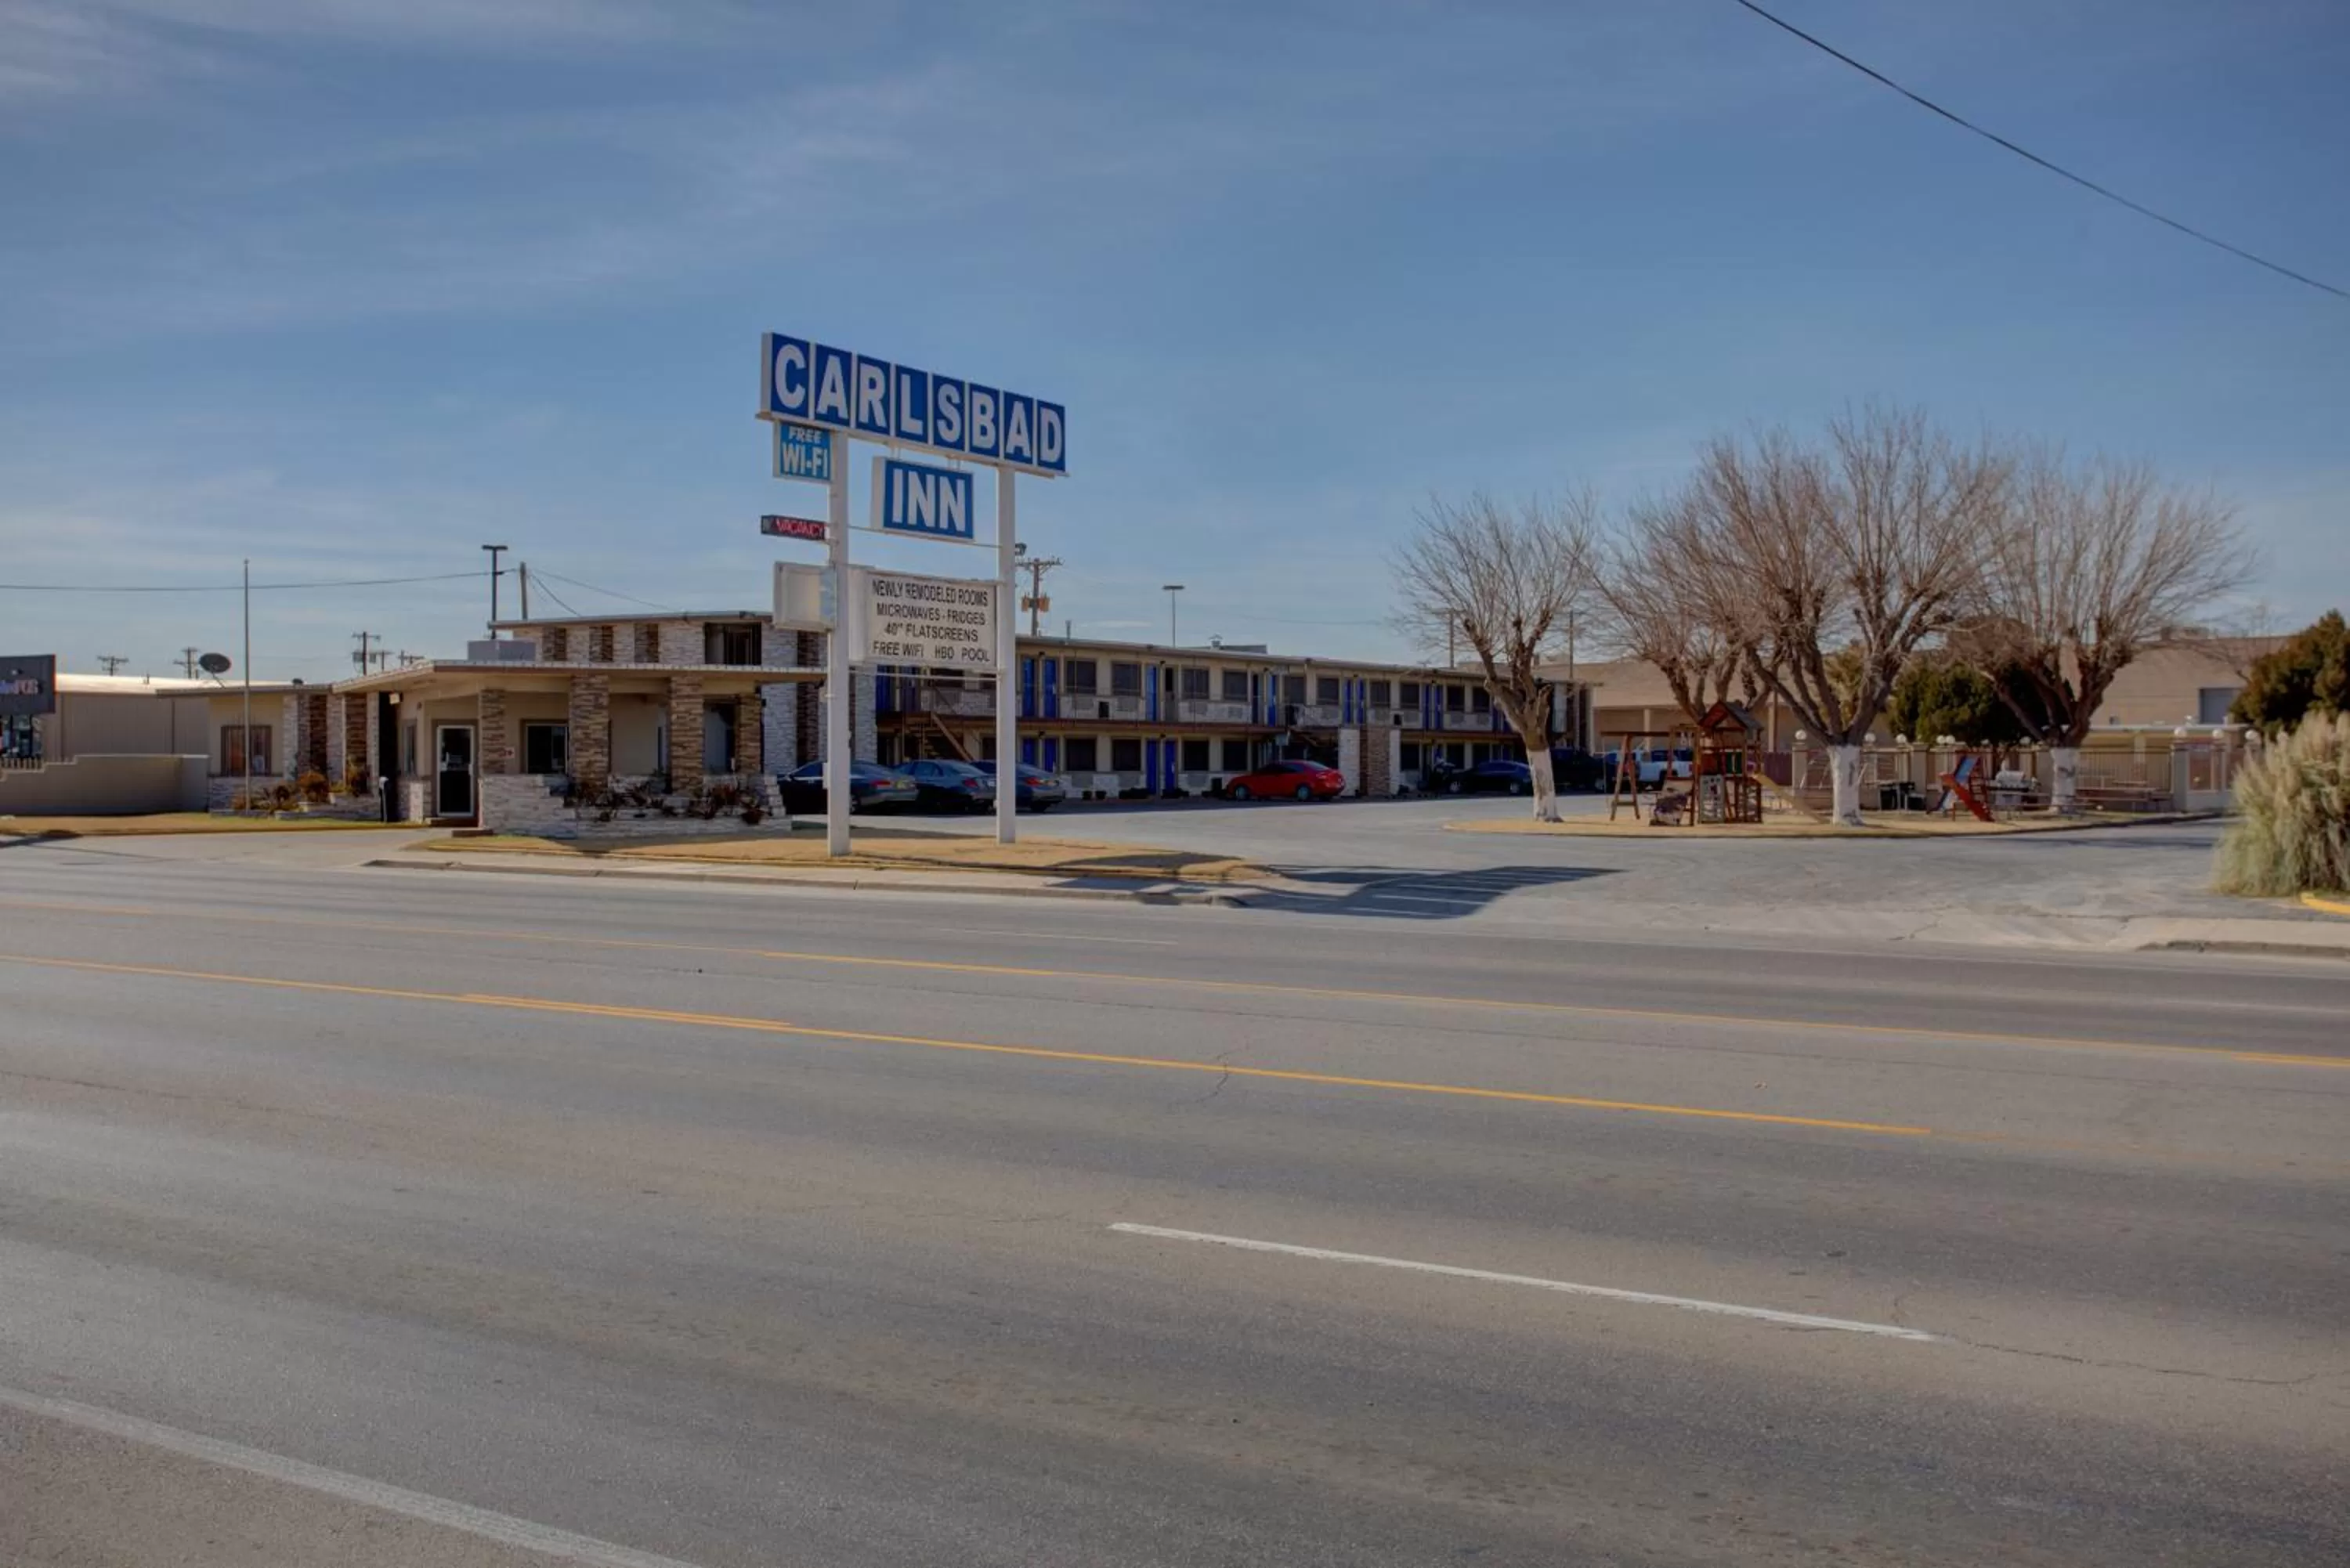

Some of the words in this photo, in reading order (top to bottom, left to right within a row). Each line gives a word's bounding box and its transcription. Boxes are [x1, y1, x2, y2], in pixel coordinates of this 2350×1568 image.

[774, 344, 1062, 463] CARLSBAD
[788, 425, 821, 443] FREE
[783, 441, 828, 477] WI-FI
[891, 468, 966, 532] INN
[776, 517, 824, 537] VACANCY
[872, 579, 903, 598] NEWLY
[905, 583, 956, 603] REMODELED
[958, 588, 988, 607] ROOMS
[877, 602, 940, 621] MICROWAVES
[946, 609, 985, 626] FRIDGES
[906, 623, 978, 642] FLATSCREENS
[873, 641, 900, 656] FREE
[902, 643, 924, 658] WIFI
[935, 645, 955, 659] HBO
[961, 647, 990, 662] POOL
